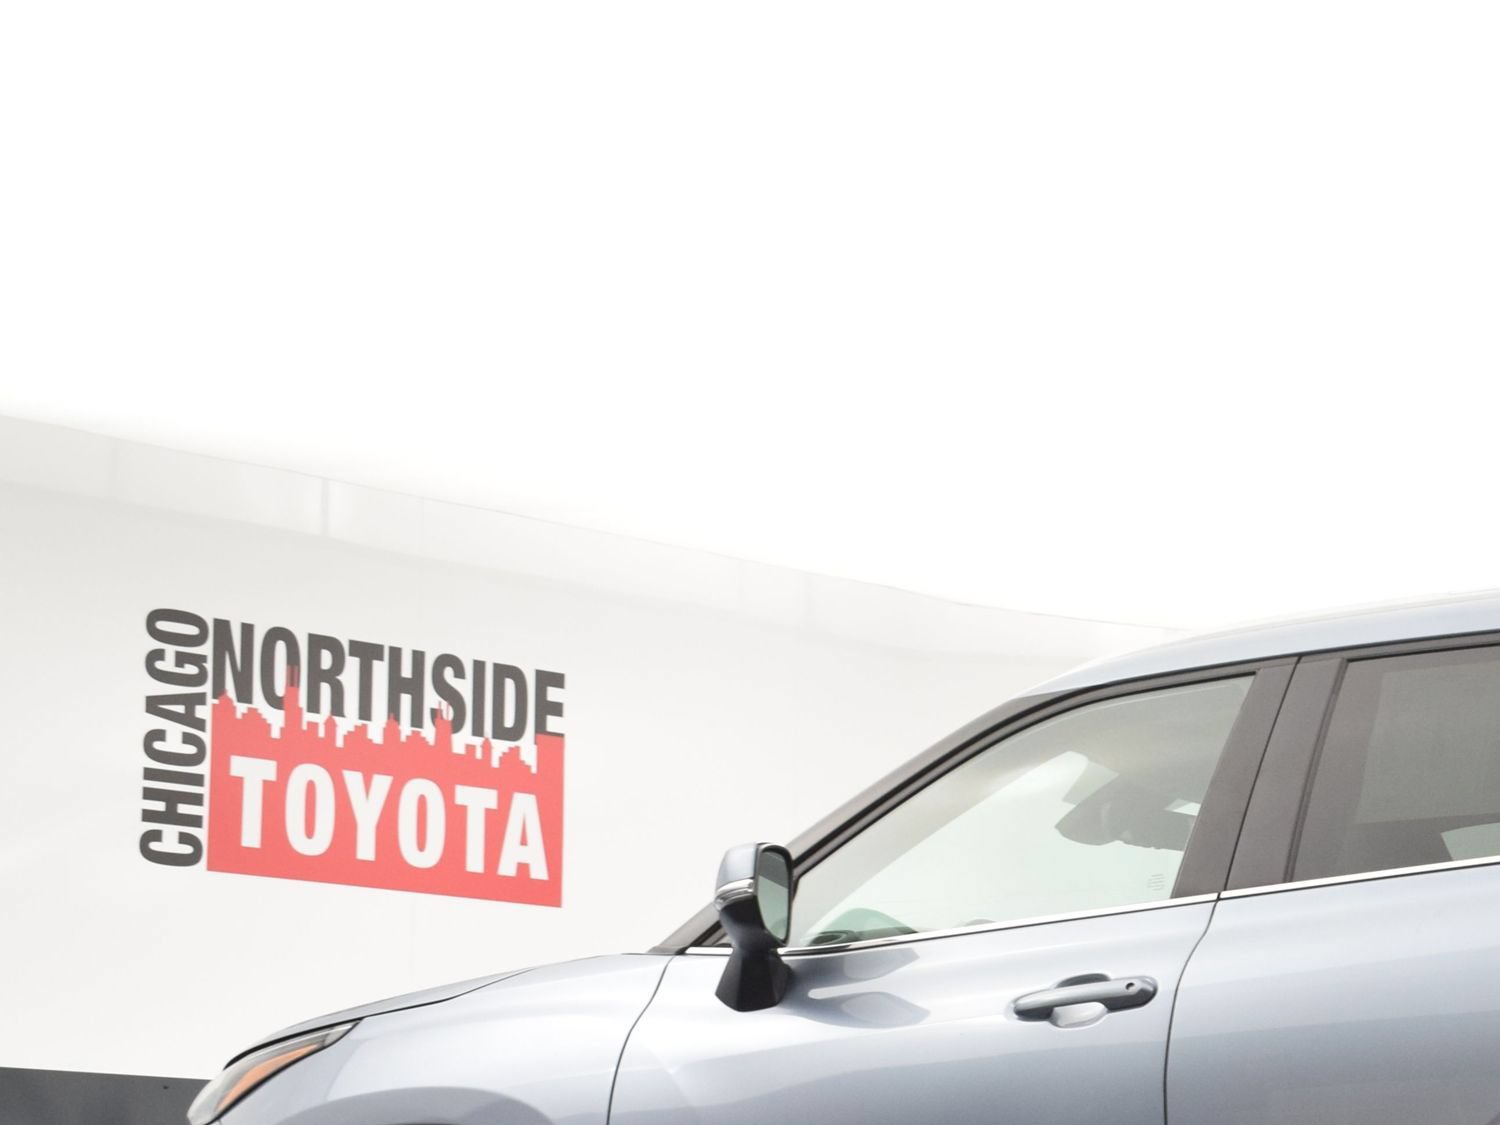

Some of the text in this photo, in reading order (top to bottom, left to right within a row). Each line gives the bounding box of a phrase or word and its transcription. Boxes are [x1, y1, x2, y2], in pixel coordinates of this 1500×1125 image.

[139, 607, 210, 868] CHICAGO
[212, 617, 566, 743] NORTHSIDE
[229, 754, 550, 881] TOYOTA
